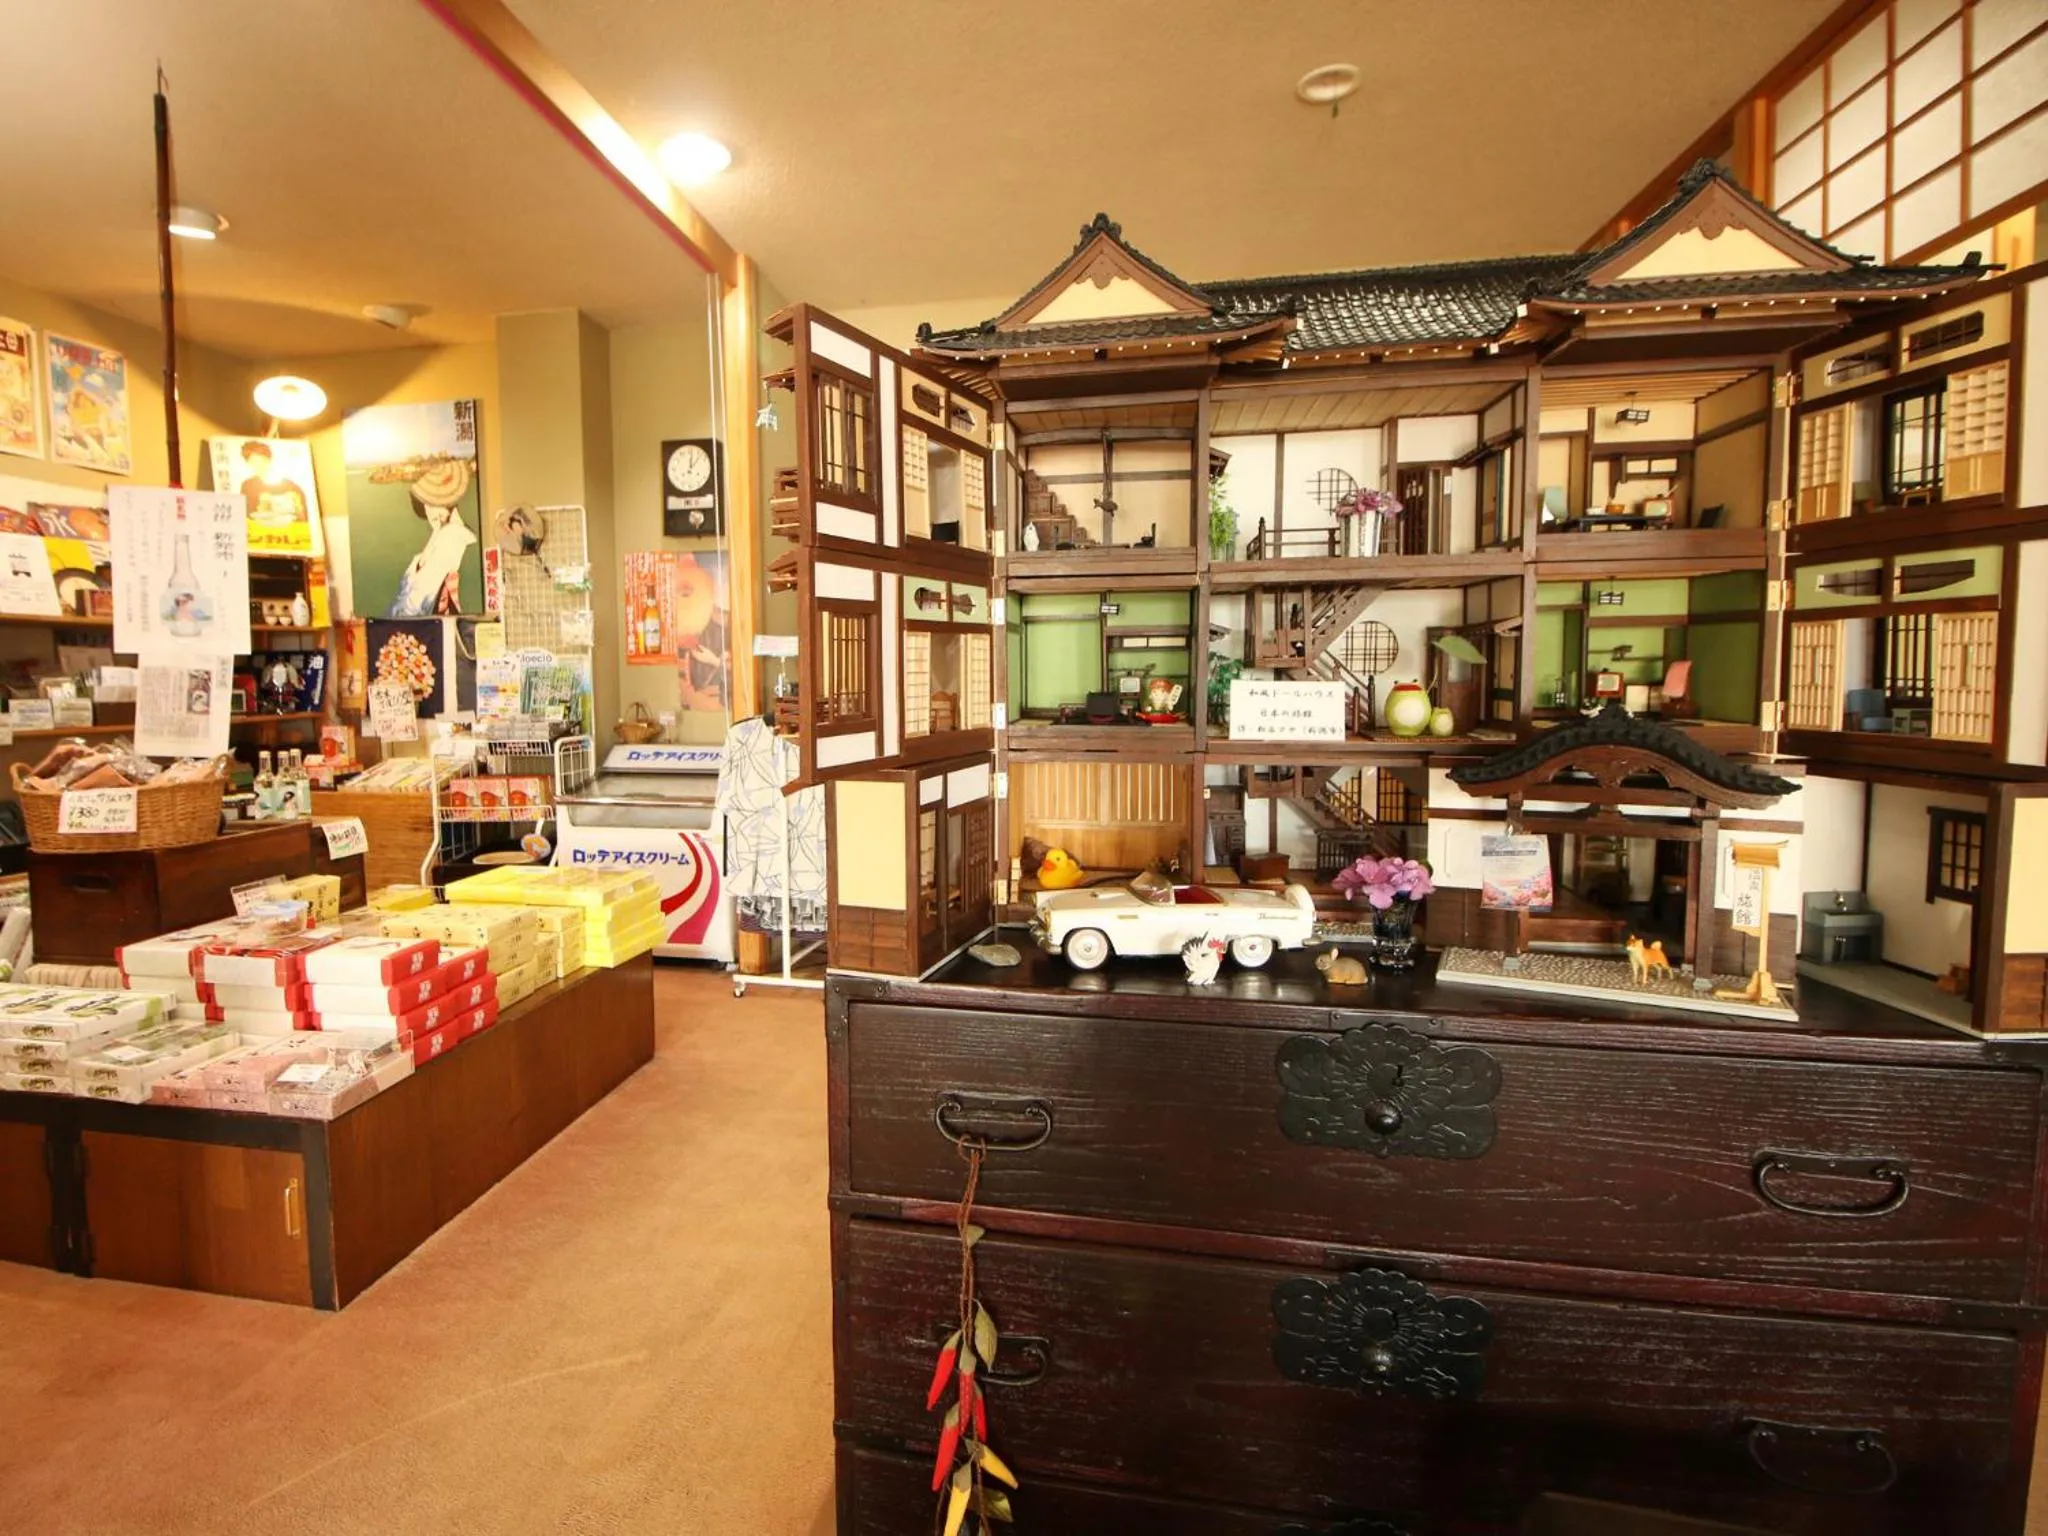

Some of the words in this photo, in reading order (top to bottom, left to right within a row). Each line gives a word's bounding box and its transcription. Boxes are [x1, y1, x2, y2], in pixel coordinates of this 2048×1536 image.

[454, 400, 474, 442] 新潟
[572, 849, 690, 866] ロッテアイスクリーム
